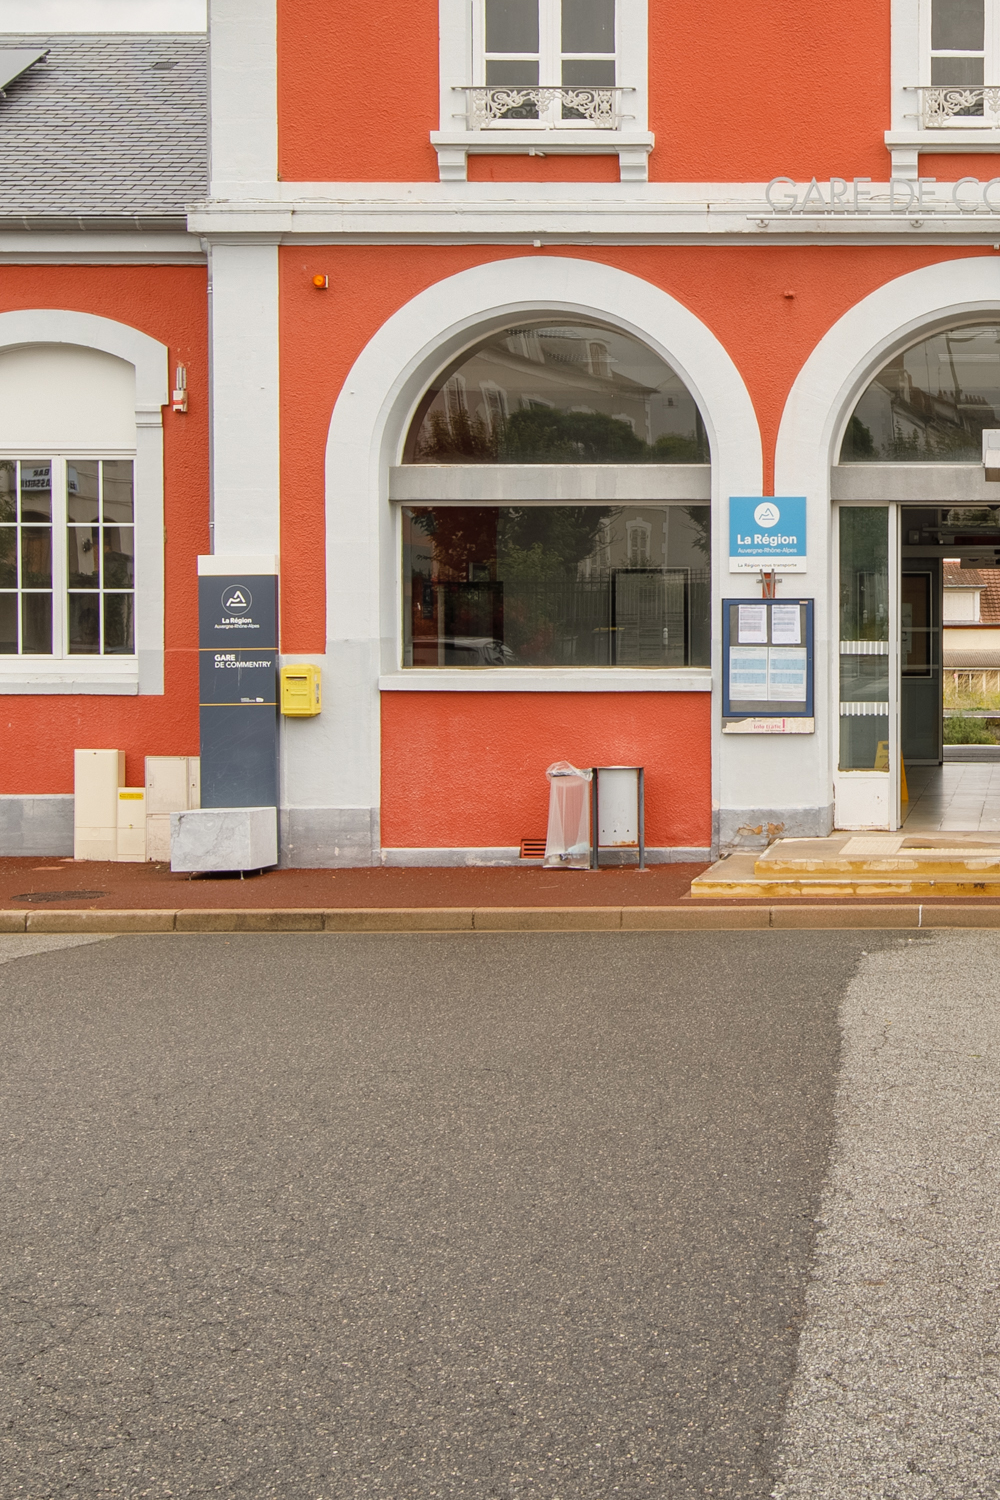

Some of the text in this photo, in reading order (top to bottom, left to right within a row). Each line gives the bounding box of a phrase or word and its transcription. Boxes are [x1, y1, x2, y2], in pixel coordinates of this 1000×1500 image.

[765, 176, 872, 211] GARE
[890, 177, 936, 211] DE
[737, 533, 797, 547] La Région
